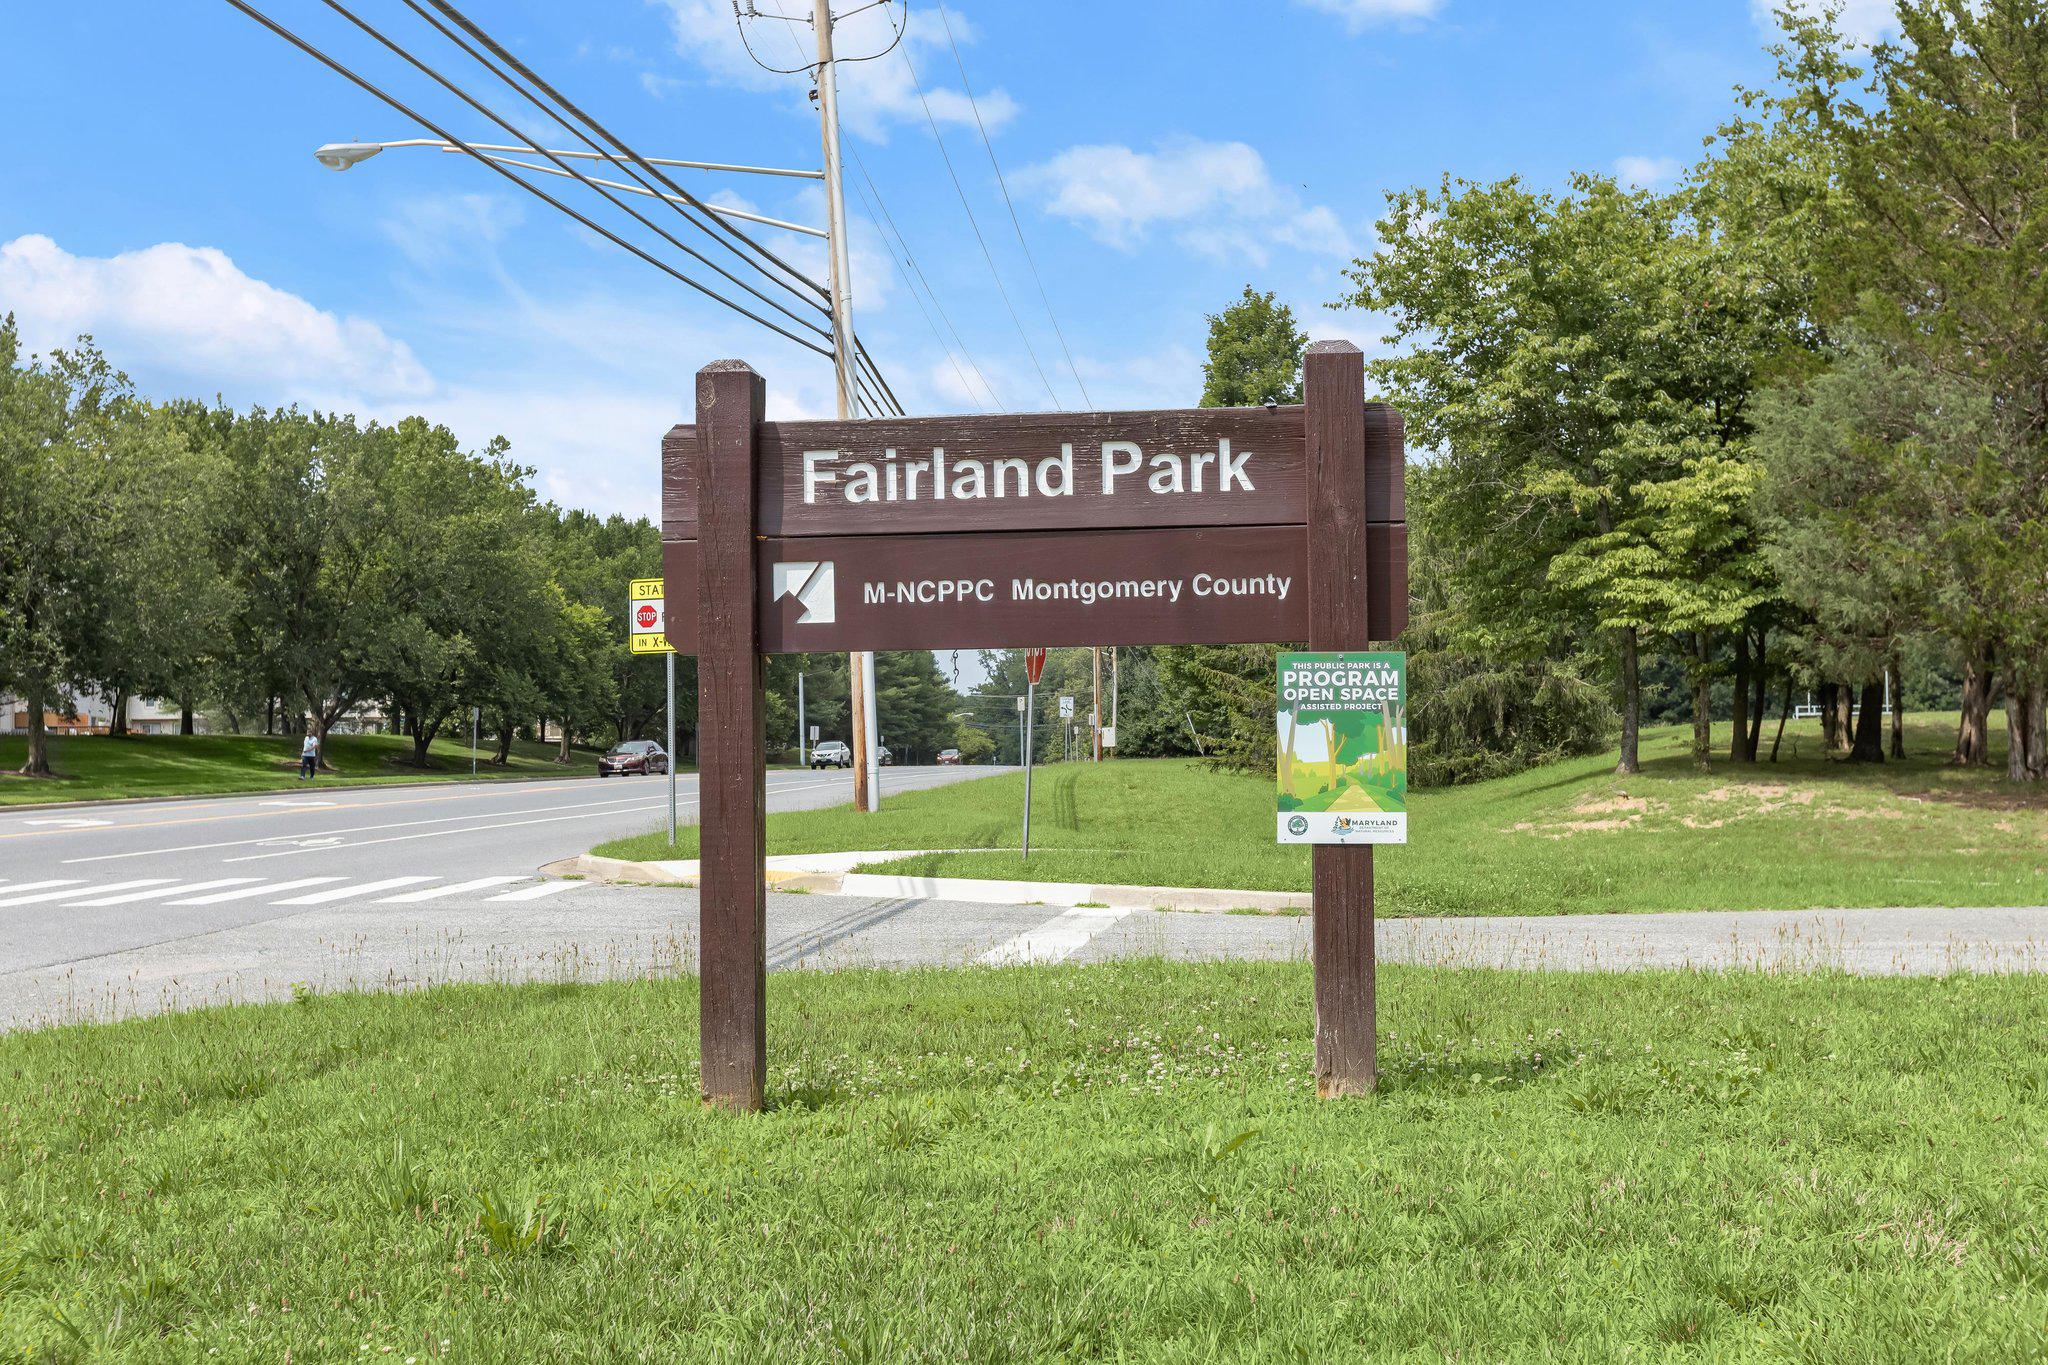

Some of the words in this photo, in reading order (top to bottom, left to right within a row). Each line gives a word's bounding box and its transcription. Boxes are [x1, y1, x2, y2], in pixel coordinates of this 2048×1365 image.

[803, 443, 1074, 504] Fairland
[1101, 437, 1256, 495] Park
[863, 579, 994, 604] M-NCPPC
[1011, 578, 1183, 605] Montgomery
[1192, 573, 1291, 600] County
[637, 612, 656, 621] STOP
[638, 638, 647, 647] IN
[1283, 670, 1399, 686] PROGRAM
[1283, 688, 1334, 700] OPEN
[1340, 687, 1399, 700] SPACE
